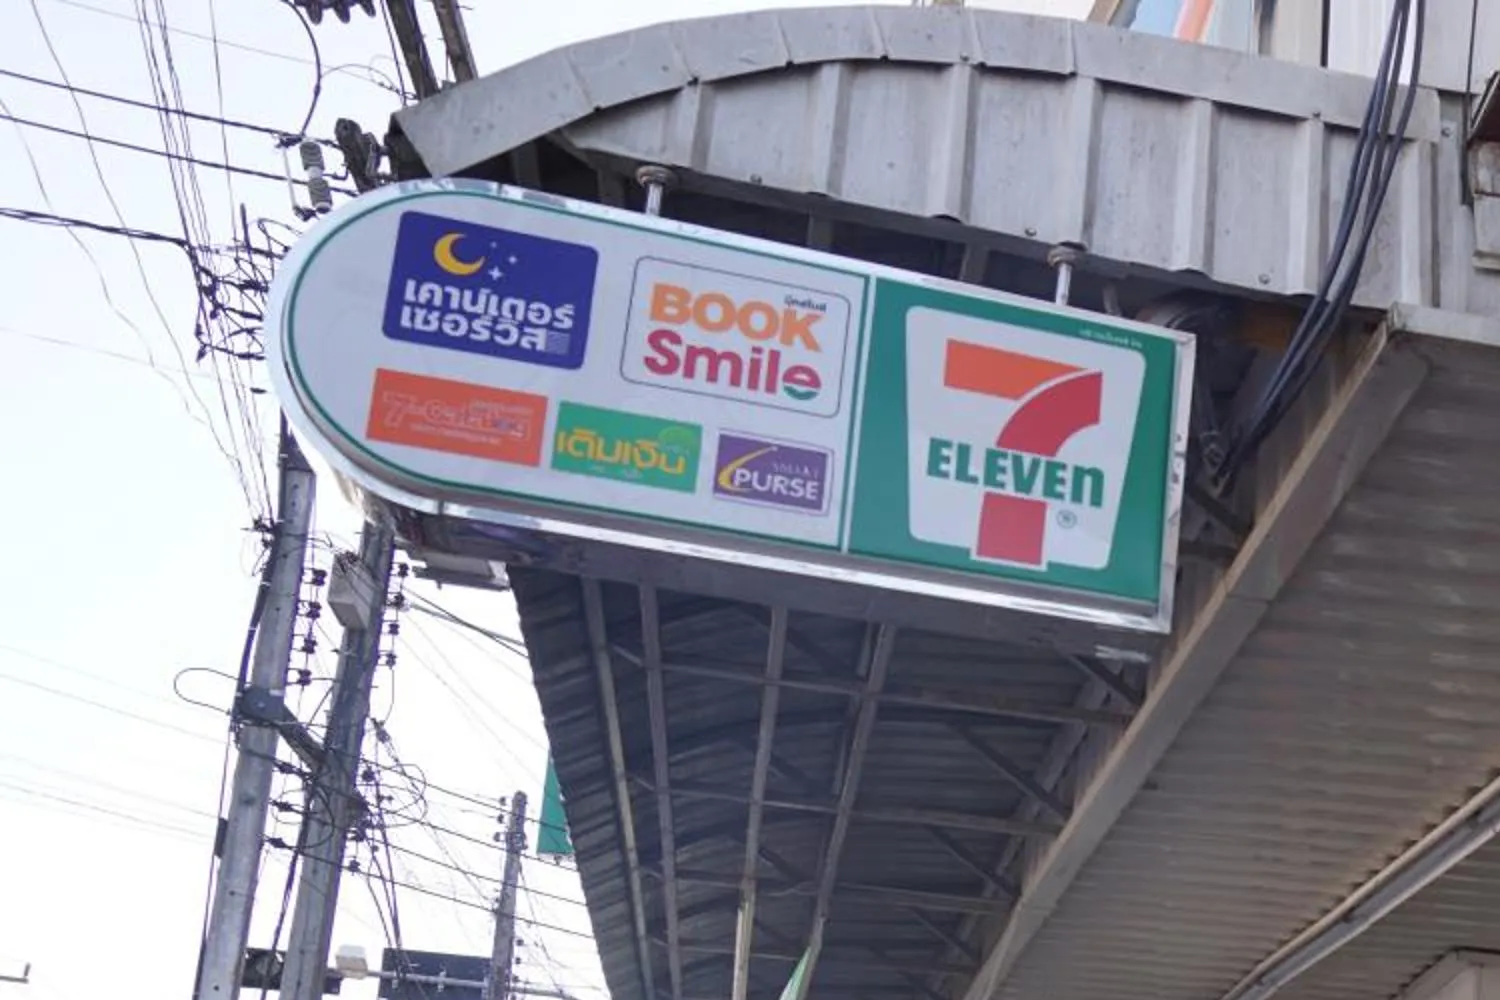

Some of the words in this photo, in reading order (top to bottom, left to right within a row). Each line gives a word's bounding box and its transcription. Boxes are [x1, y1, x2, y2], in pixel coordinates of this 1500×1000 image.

[650, 282, 822, 353] BOOK
[643, 328, 822, 401] Smile
[733, 467, 820, 501] PURSE
